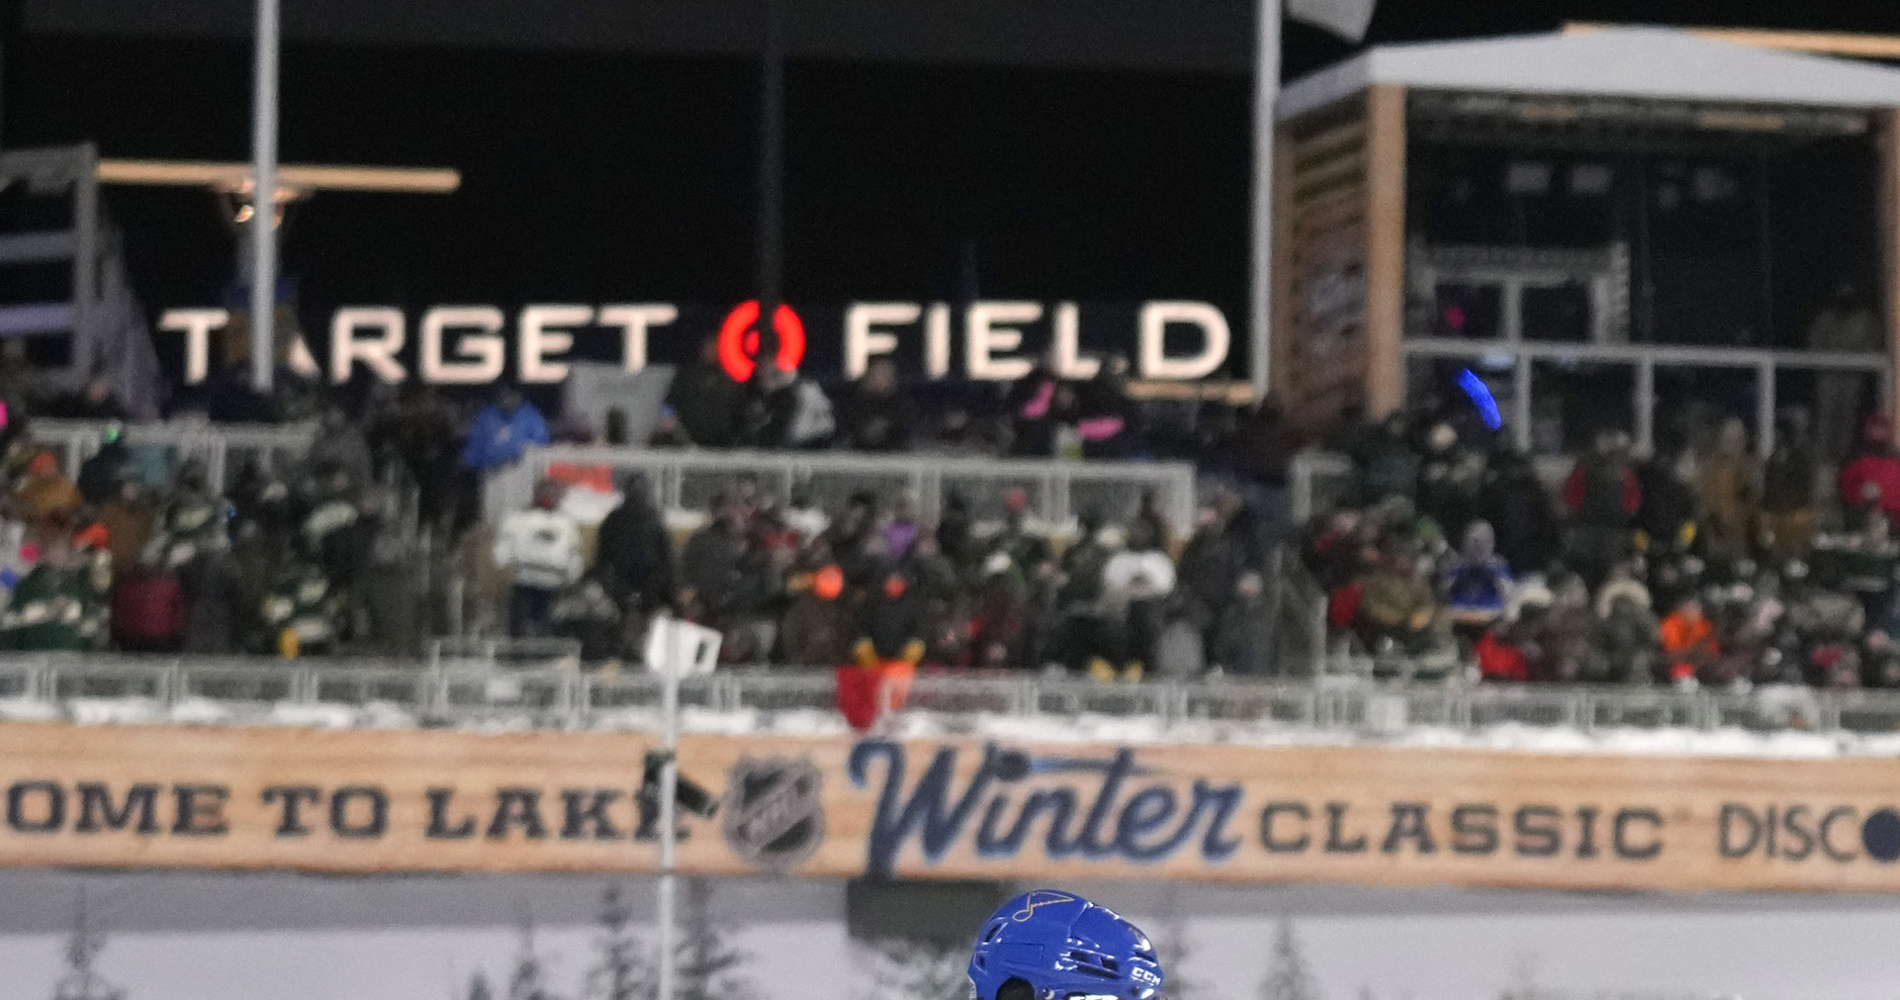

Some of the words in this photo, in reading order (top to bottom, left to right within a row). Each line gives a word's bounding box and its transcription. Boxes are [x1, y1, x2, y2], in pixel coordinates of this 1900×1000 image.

[843, 299, 1232, 382] FIELD
[262, 784, 390, 840] TO
[849, 739, 1245, 880] Winter
[1258, 800, 1665, 860] CLASSIC
[1131, 966, 1162, 986] CCM
